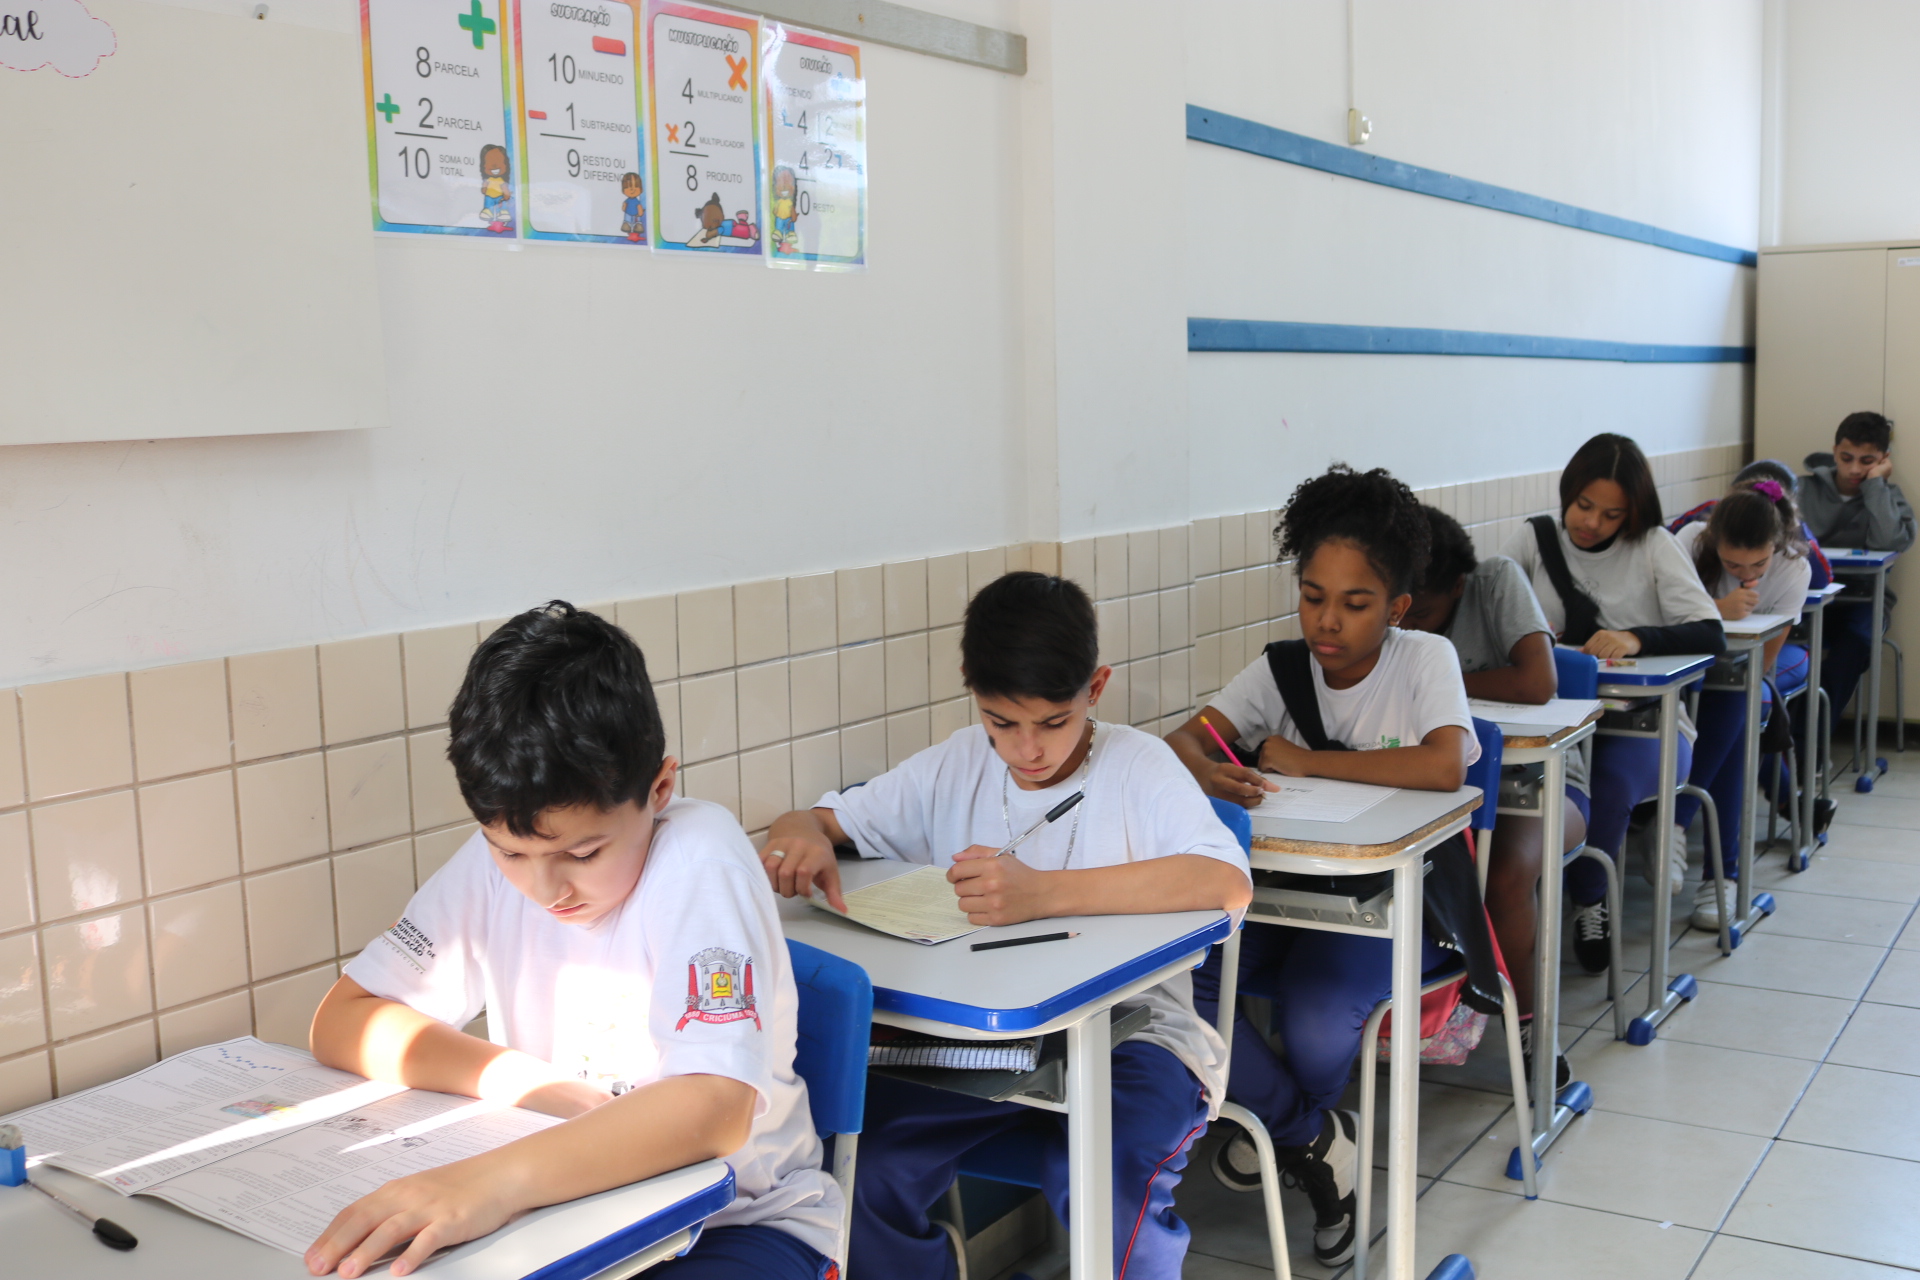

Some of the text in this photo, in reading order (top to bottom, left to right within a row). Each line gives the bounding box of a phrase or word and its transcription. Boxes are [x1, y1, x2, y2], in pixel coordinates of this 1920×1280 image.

[0, 10, 44, 41] al
[550, 2, 611, 27] SUBTRAÇÃO
[668, 28, 739, 55] MULTIPLICAÇÃO
[416, 46, 480, 78] 8 PARCELA
[548, 52, 624, 85] 10 MINUENDO
[800, 55, 832, 75] DIVISÃO
[681, 77, 743, 104] 4 MULTIPLICANDO
[418, 97, 483, 131] 2 PARCELA
[565, 102, 632, 133] 1 SUBTRAENDO
[797, 110, 808, 135] 4
[684, 120, 745, 149] 2 MULTIPLICADOR
[398, 146, 430, 179] 10
[439, 154, 475, 166] SOMA OU
[440, 166, 465, 177] TOTAL
[567, 148, 581, 178] 9
[582, 155, 626, 169] RESTO OU
[799, 147, 834, 175] 4 2
[686, 164, 743, 191] 8 PRODUTO
[812, 202, 836, 214] RESTO
[401, 917, 434, 949] SECRETARIA
